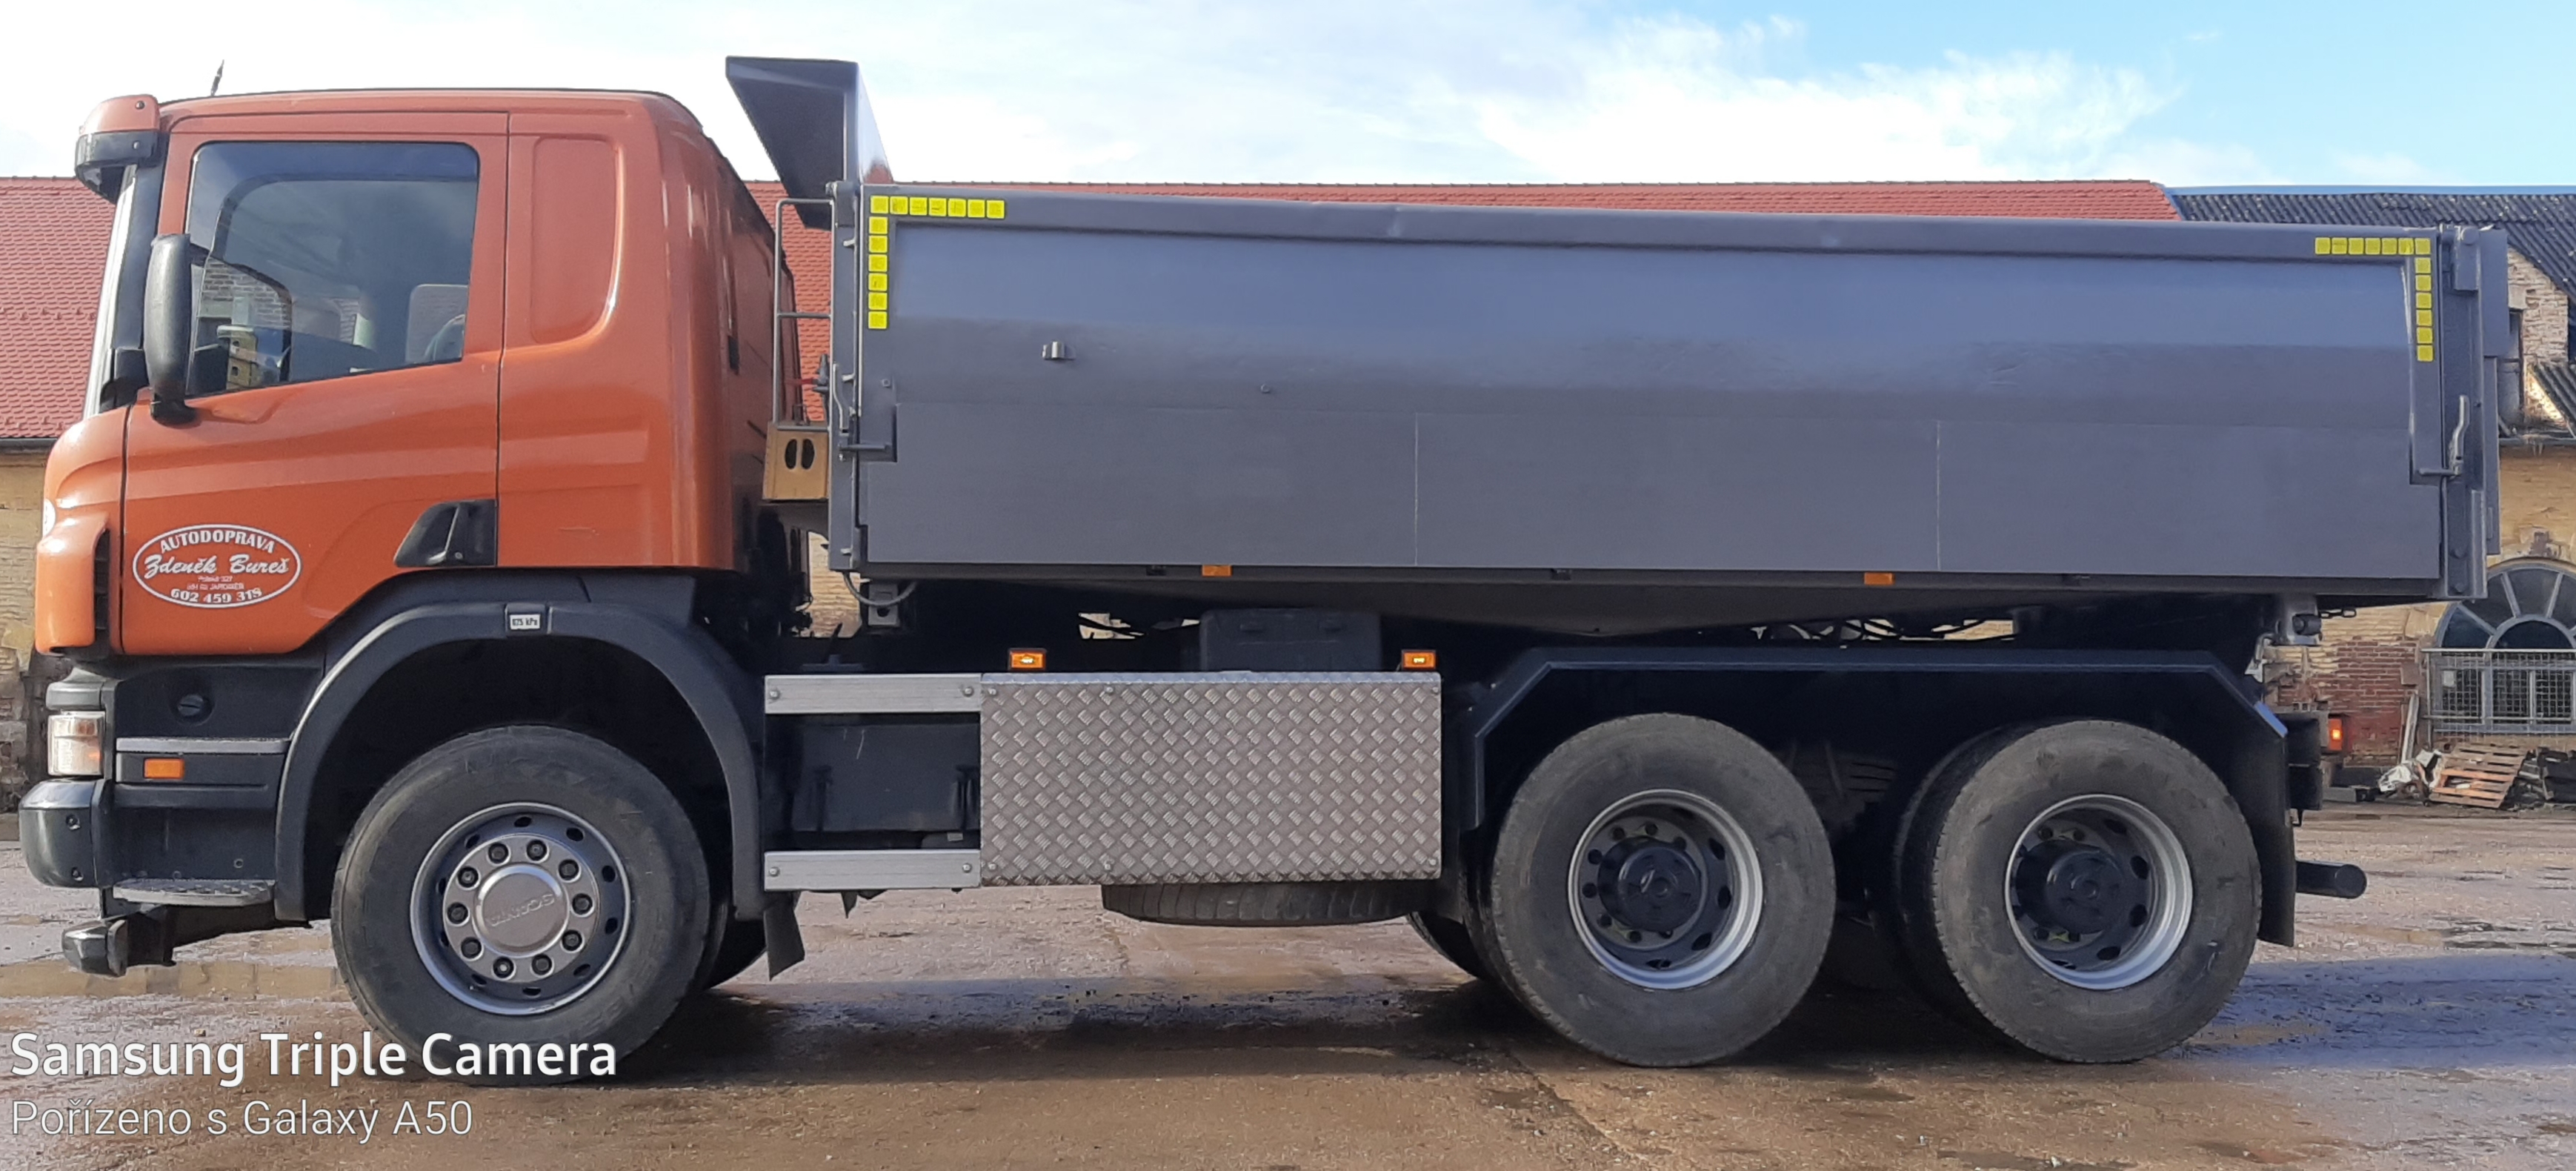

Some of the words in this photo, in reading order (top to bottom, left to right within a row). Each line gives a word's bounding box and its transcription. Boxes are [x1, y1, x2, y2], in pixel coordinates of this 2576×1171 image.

[160, 529, 276, 554] AUTODOPRAVA
[144, 554, 218, 580] Zdeněk
[229, 554, 290, 574] Bureš
[170, 588, 199, 603] 602
[203, 592, 232, 603] 459
